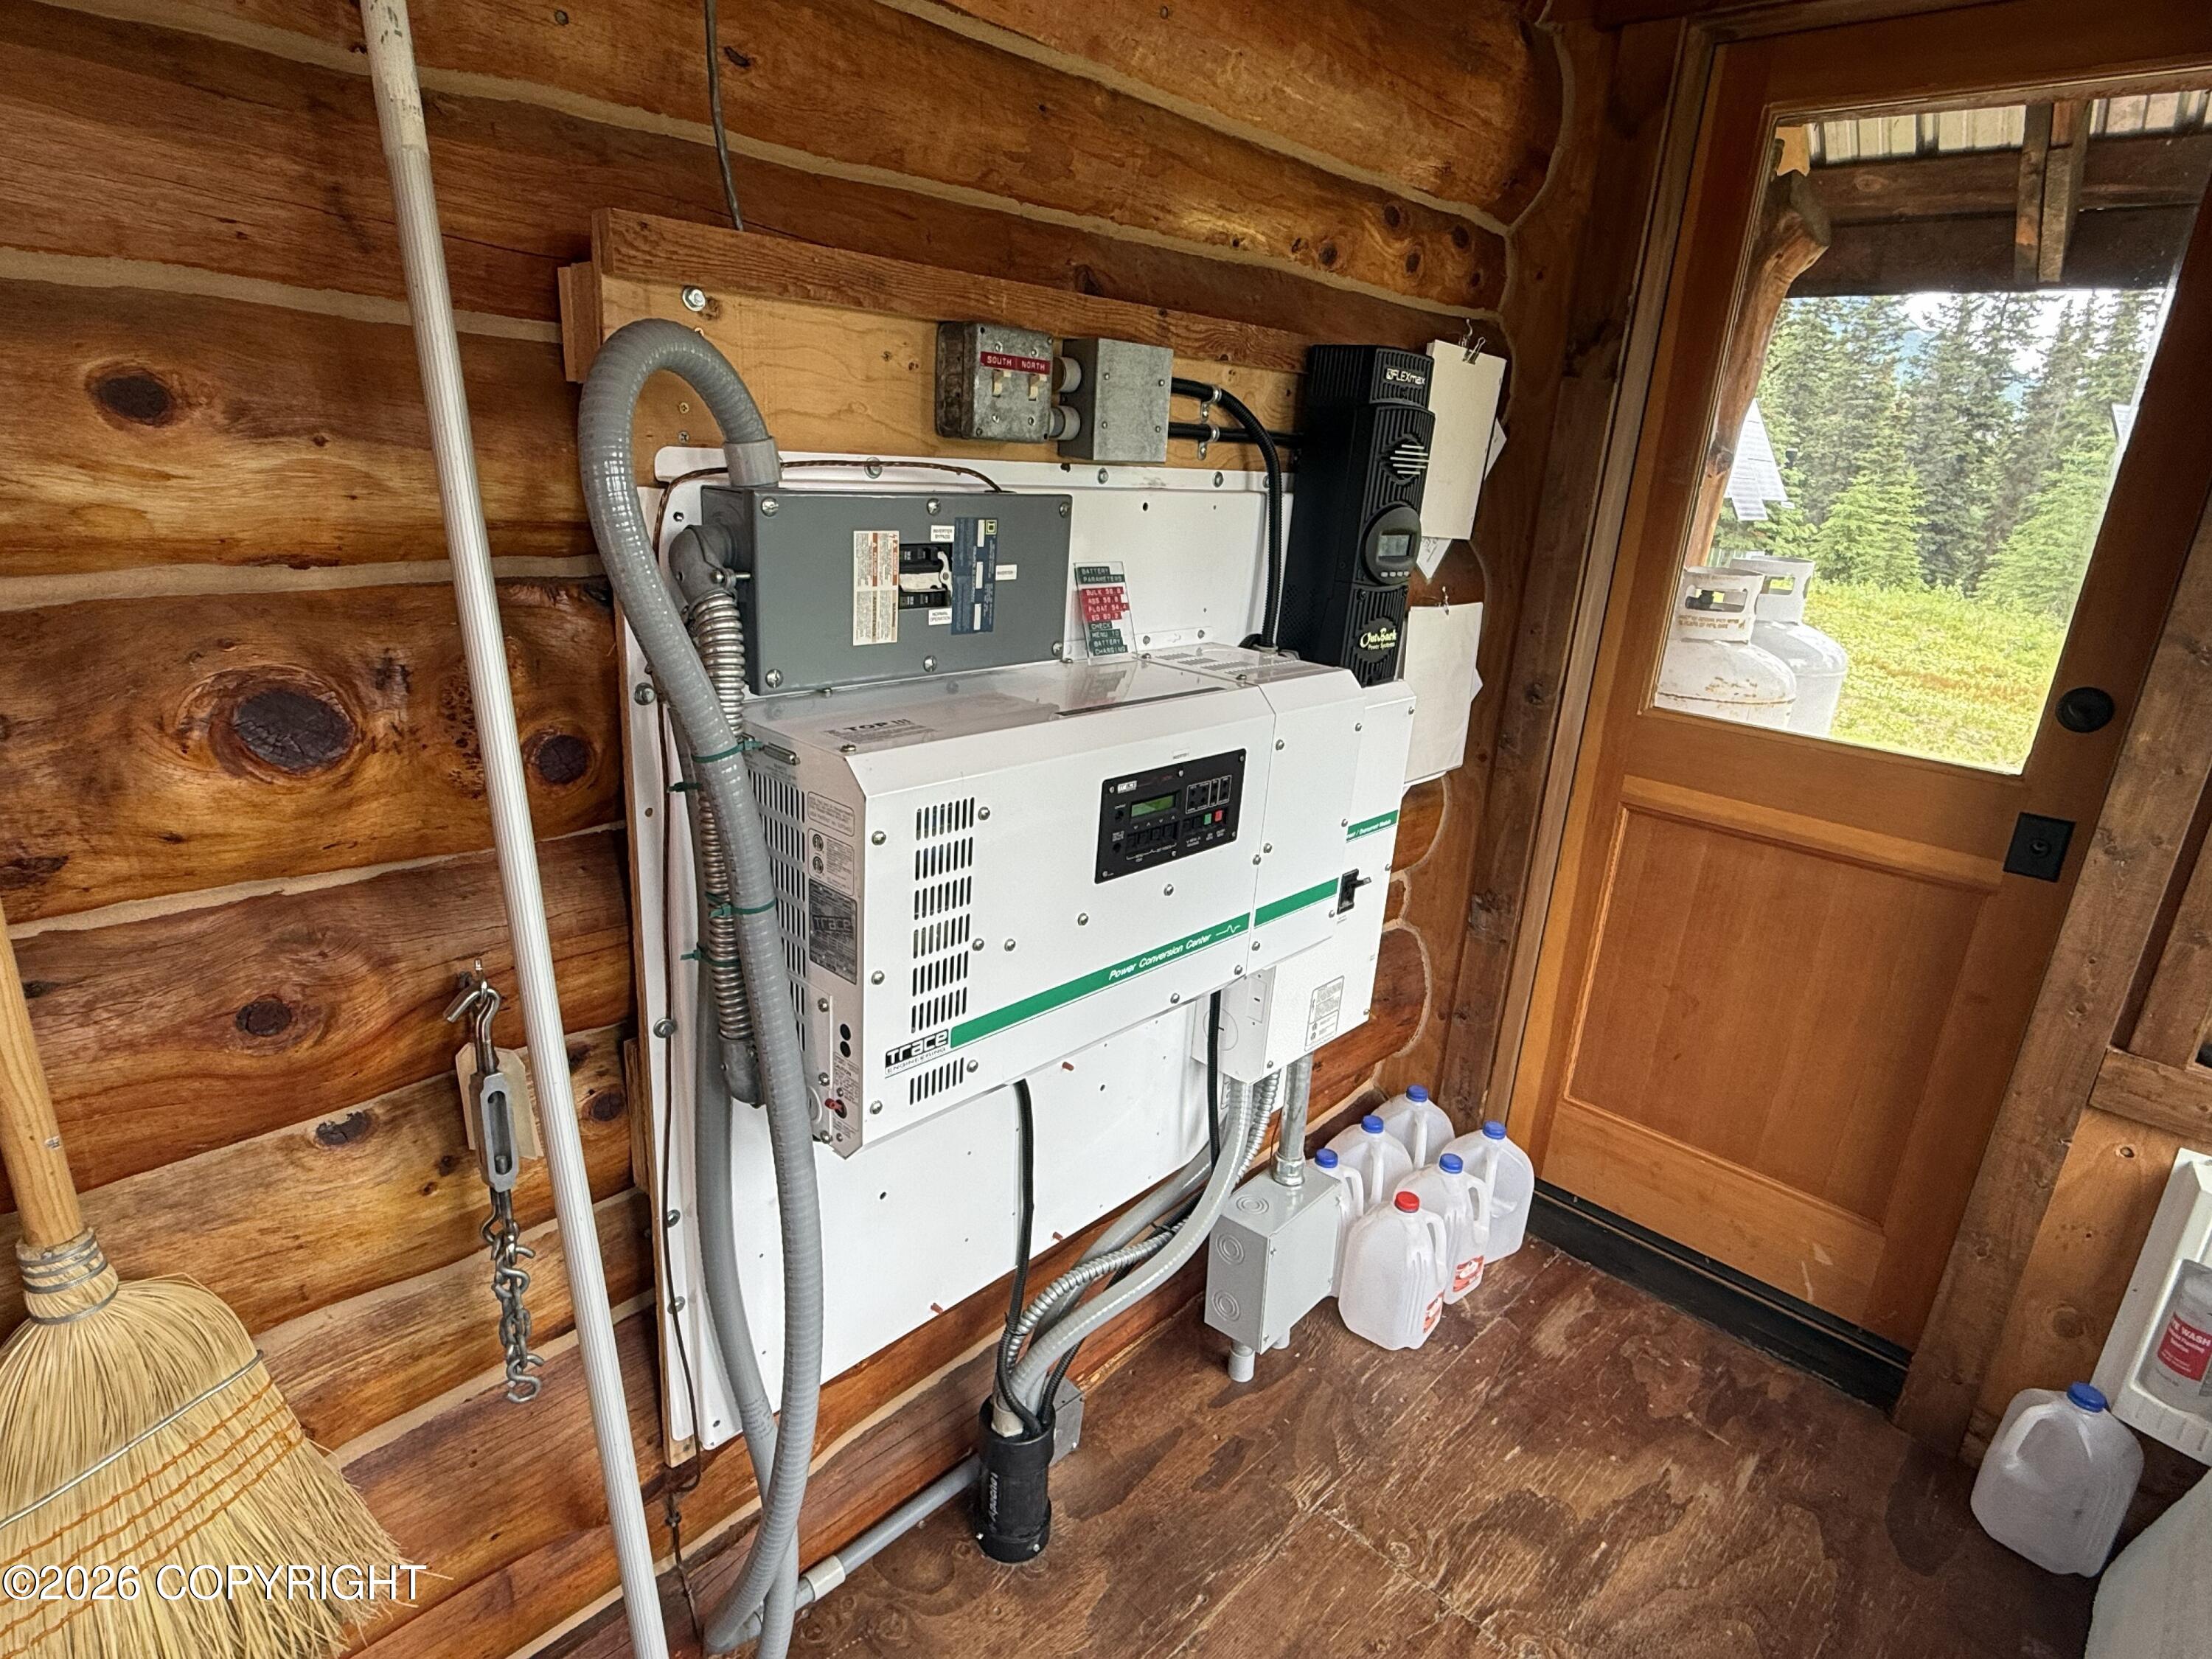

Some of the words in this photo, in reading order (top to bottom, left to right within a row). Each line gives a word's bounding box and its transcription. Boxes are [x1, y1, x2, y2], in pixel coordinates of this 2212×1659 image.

[987, 355, 1012, 366] SOUTH
[1021, 360, 1046, 371] NORTH
[1094, 639, 1120, 647] BATTERY
[1096, 647, 1125, 655] CHARGING
[844, 722, 888, 731] TOP
[1108, 963, 1137, 981] Power
[1138, 945, 1184, 968] Conversion
[1186, 933, 1212, 950] Center
[886, 1030, 948, 1064] Trace
[887, 1047, 946, 1074] ENGINEERING
[2181, 1326, 2211, 1347] WASH
